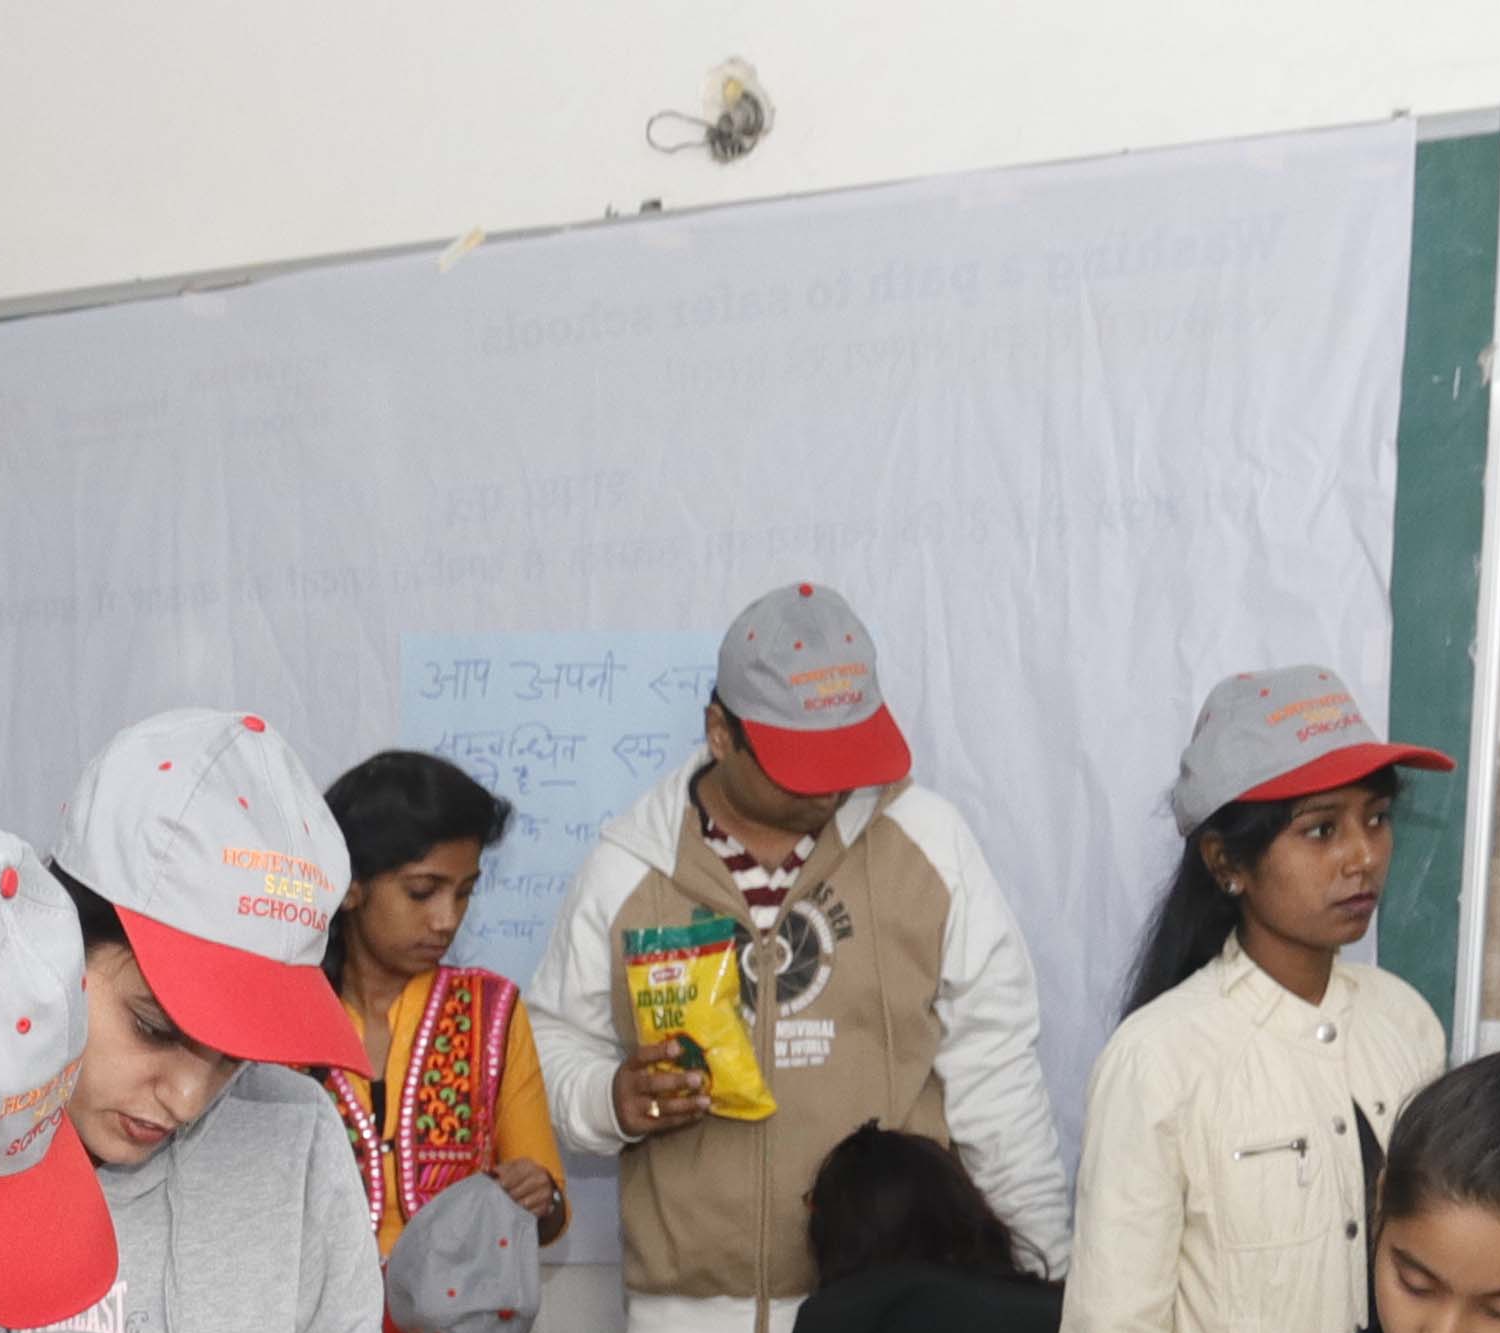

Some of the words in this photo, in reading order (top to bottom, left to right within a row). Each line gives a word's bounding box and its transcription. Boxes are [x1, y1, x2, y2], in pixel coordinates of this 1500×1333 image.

[264, 873, 314, 902] SAFE
[237, 895, 328, 933] SCHOOLS
[636, 984, 698, 1009] mango
[651, 1007, 686, 1031] bite
